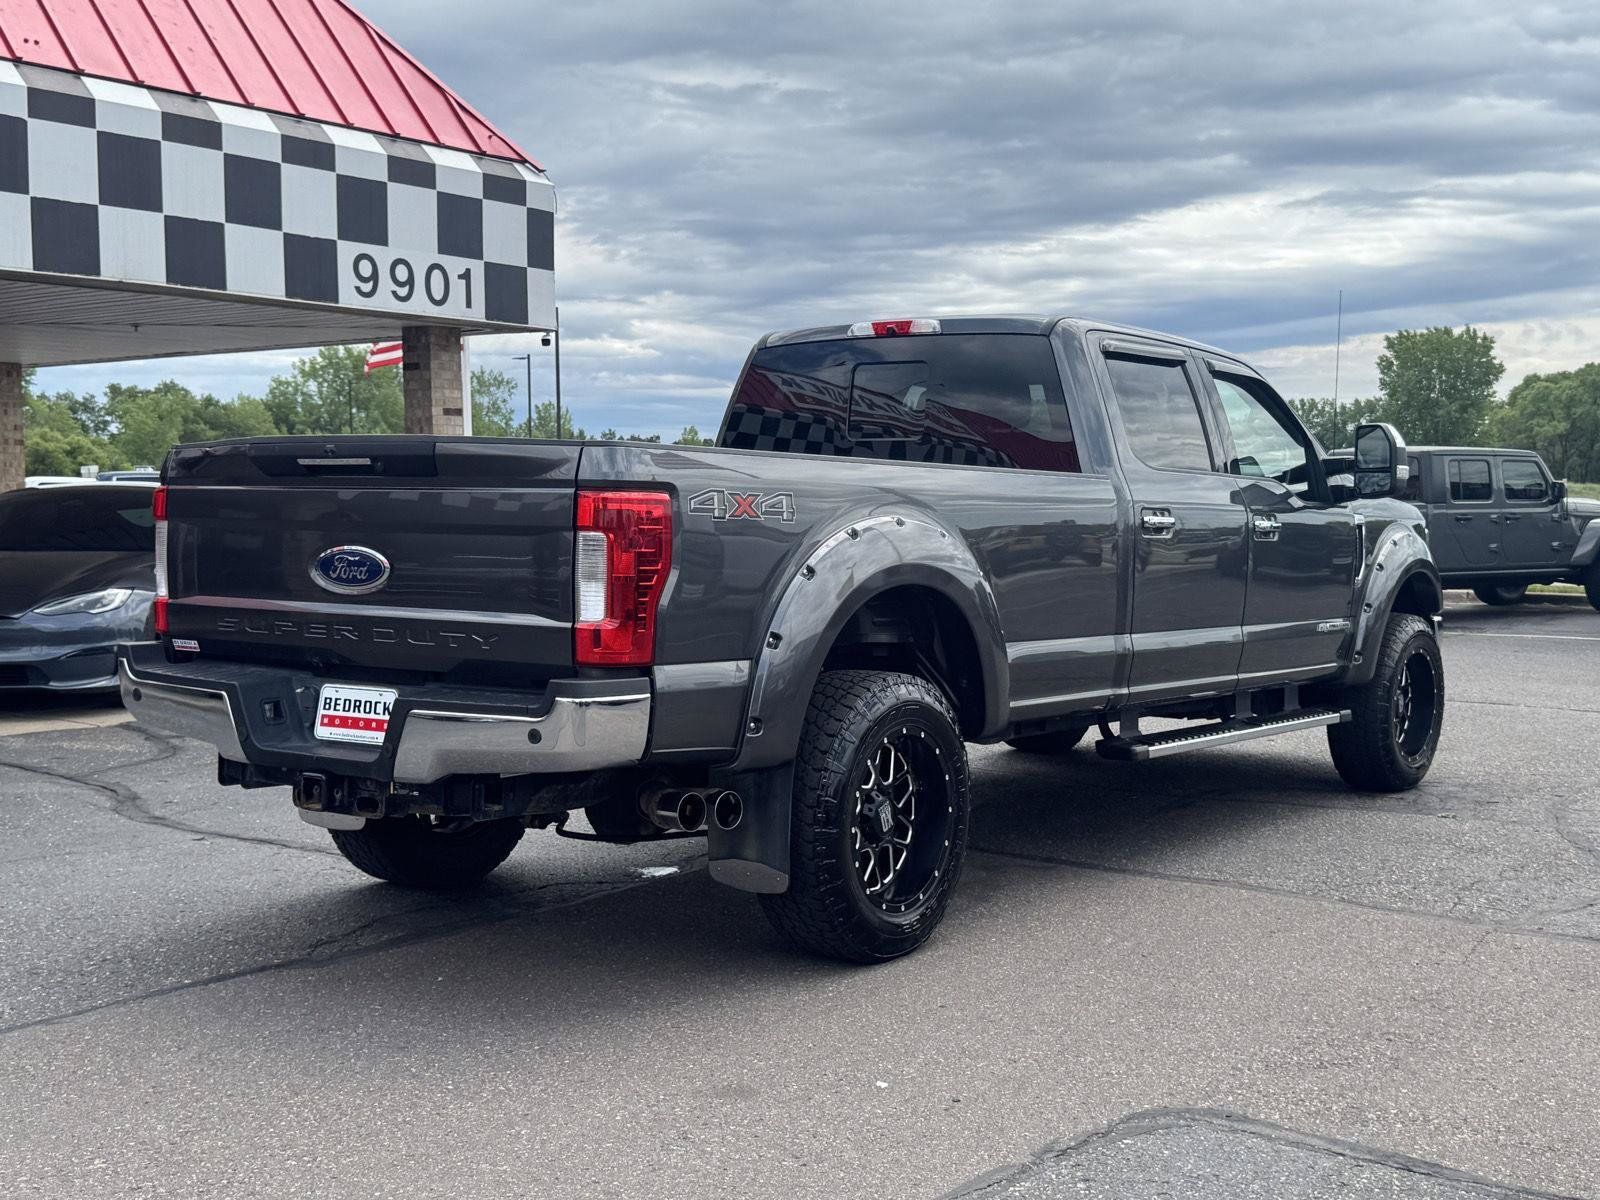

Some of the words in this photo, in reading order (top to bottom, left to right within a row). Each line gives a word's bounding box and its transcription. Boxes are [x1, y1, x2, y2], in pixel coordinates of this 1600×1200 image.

[353, 253, 473, 309] 9901
[329, 554, 370, 580] Ford
[216, 618, 359, 640] SUPER
[372, 628, 498, 649] DUTY
[323, 697, 392, 716] BEDROCK
[323, 718, 388, 730] MOTORS
